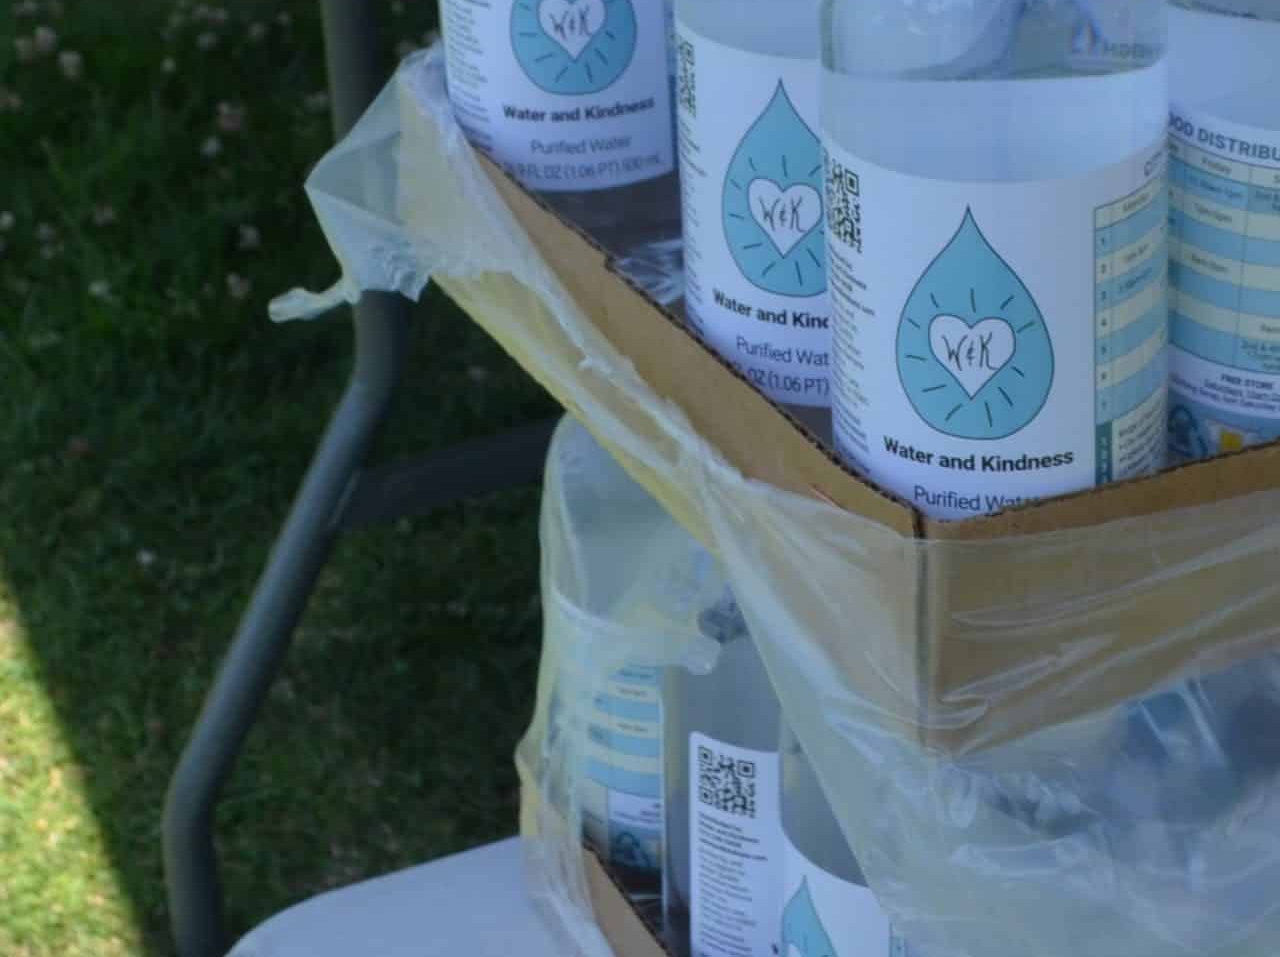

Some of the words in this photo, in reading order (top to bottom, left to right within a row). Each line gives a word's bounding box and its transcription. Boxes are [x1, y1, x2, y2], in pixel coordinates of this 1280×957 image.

[503, 104, 546, 122] Water
[550, 107, 580, 122] and
[585, 97, 655, 120] Kindness
[530, 138, 586, 155] Purified
[590, 135, 633, 153] Water
[713, 287, 752, 317] Water
[756, 309, 787, 325] and
[736, 333, 793, 363] Purified
[942, 332, 1001, 371] W&K
[804, 376, 830, 396] PT)
[883, 434, 935, 465] Water
[939, 454, 976, 471] and
[981, 451, 1075, 472] Kindness
[914, 485, 981, 512] Purified
